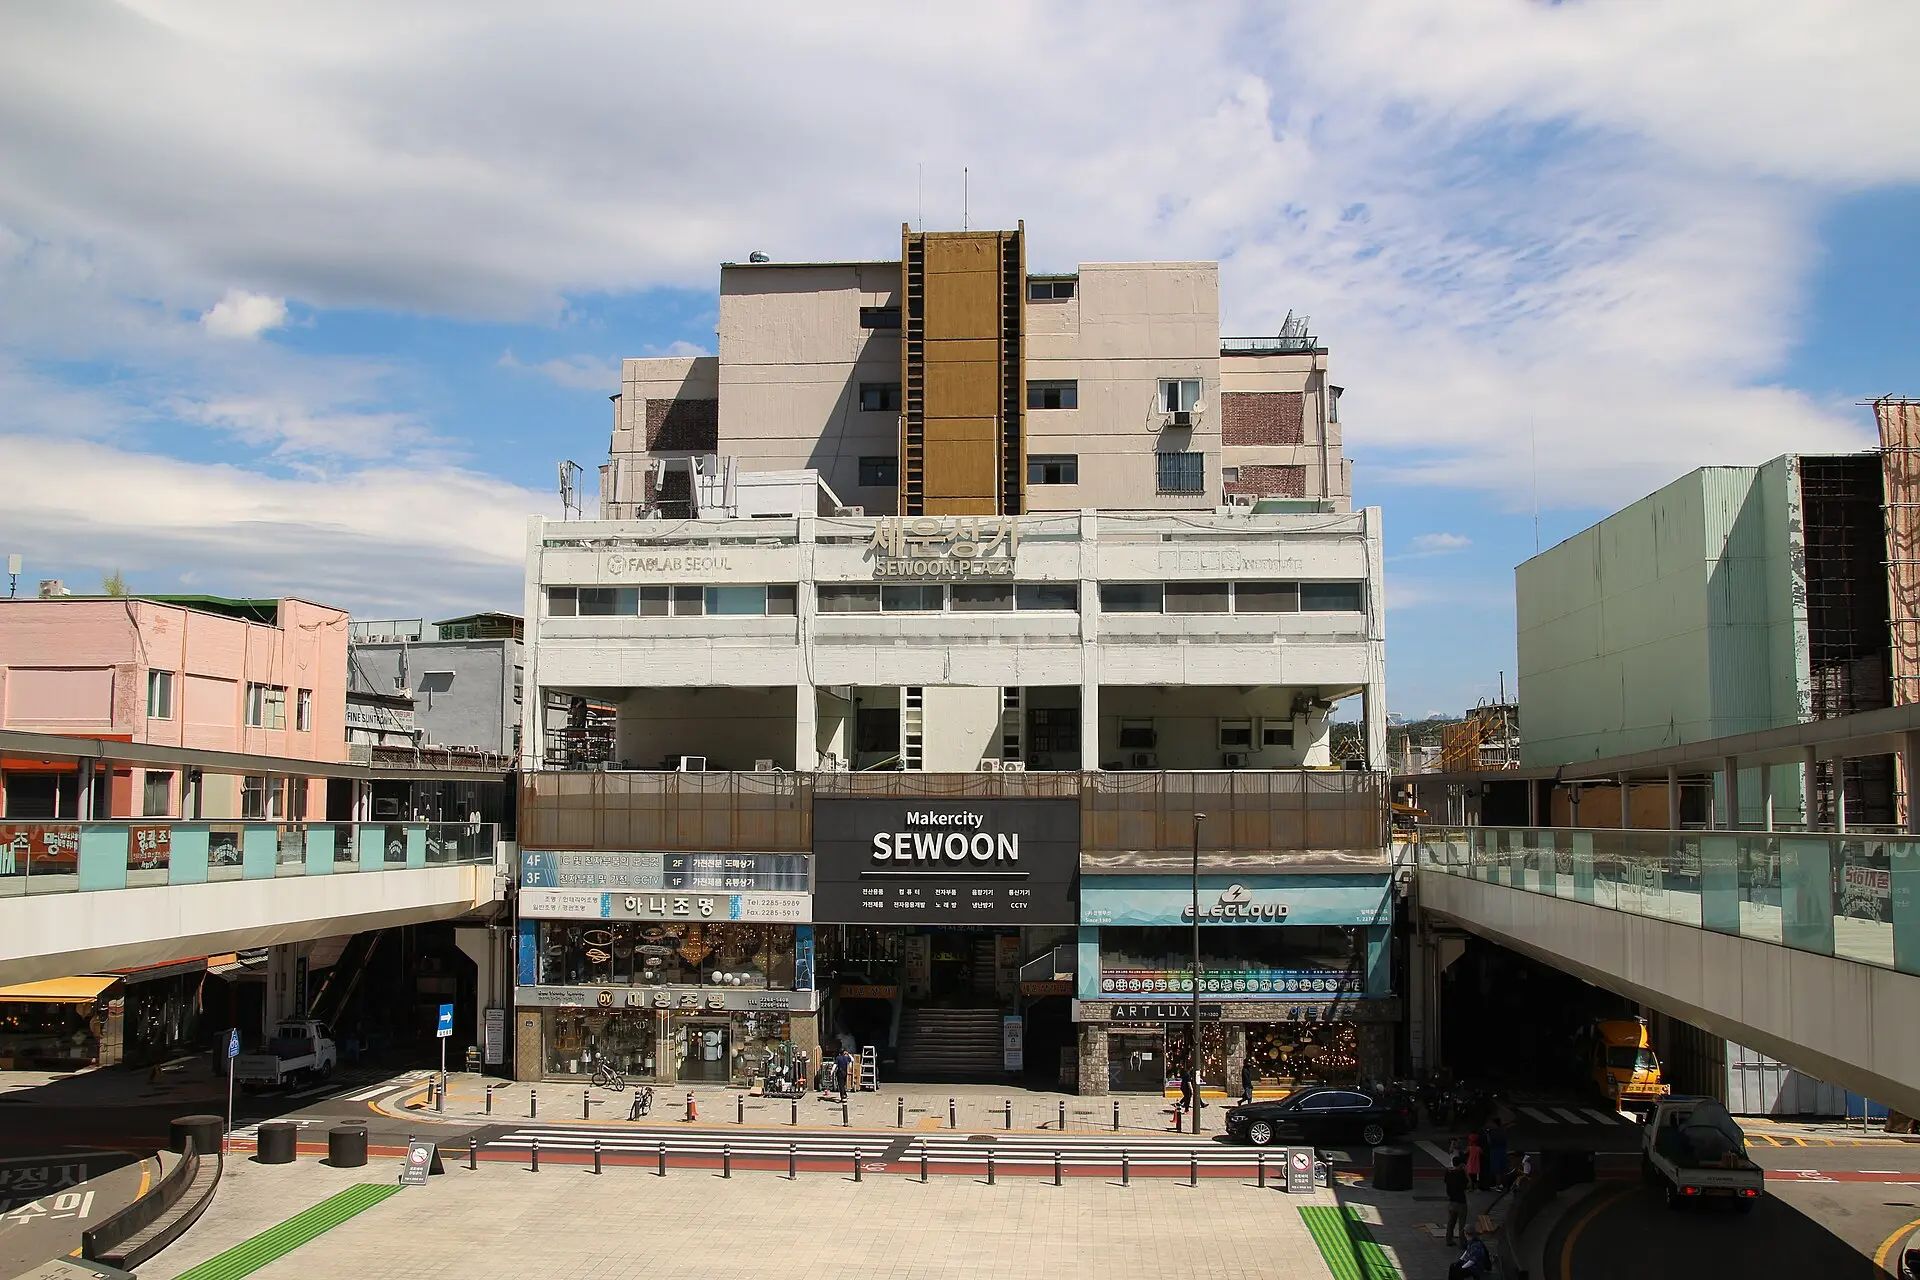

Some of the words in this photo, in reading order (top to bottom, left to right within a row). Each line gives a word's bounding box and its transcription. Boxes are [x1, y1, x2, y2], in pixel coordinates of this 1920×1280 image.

[869, 517, 1019, 558] 세운상가
[628, 557, 681, 573] FABLAB
[686, 557, 732, 572] SEOUL
[875, 559, 953, 576] SEWOON
[959, 559, 1016, 575] PLAZA
[347, 712, 361, 722] FINE
[906, 811, 984, 829] Makercity
[137, 830, 172, 855] 영광조
[873, 832, 1019, 860] SEWOON
[526, 854, 541, 867] 4F
[672, 859, 684, 868] 2F
[526, 872, 541, 884] 3F
[633, 874, 660, 886] CCTV
[672, 877, 683, 887] 1F
[625, 896, 714, 917] 하나조명
[1010, 902, 1028, 910] CCTV
[600, 993, 612, 1003] DY
[627, 991, 725, 1009] 대영조명
[1116, 1005, 1150, 1017] ART
[1157, 1005, 1190, 1017] LUX
